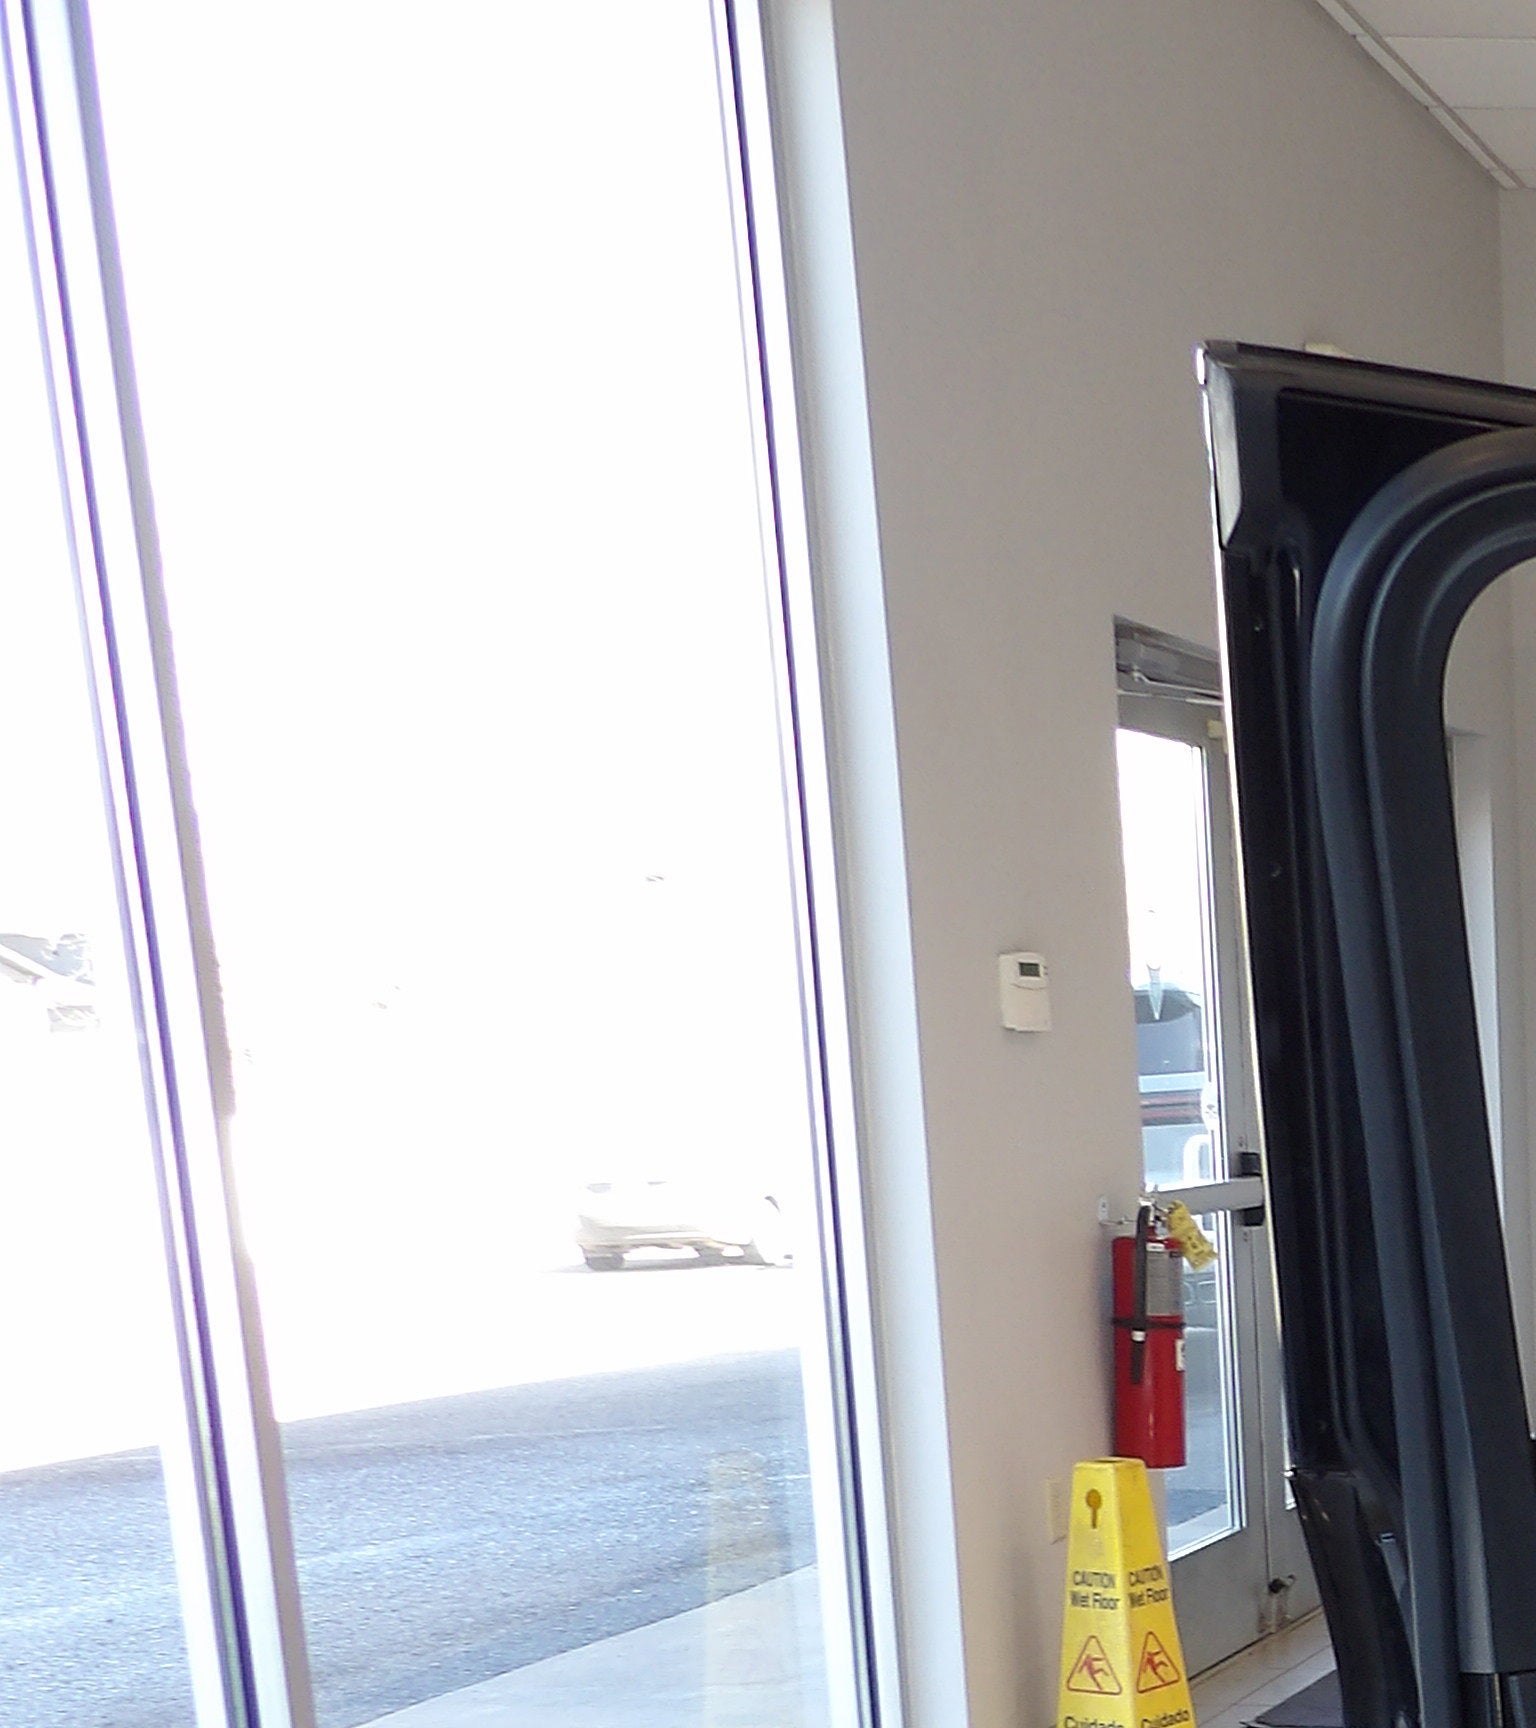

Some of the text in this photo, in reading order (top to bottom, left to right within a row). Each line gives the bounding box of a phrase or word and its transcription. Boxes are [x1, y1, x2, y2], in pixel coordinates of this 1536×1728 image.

[1073, 1571, 1116, 1588] CAUTION
[1128, 1564, 1164, 1587] CAUTION
[1069, 1590, 1120, 1610] Wet Floor
[1129, 1587, 1169, 1609] Wet Floor
